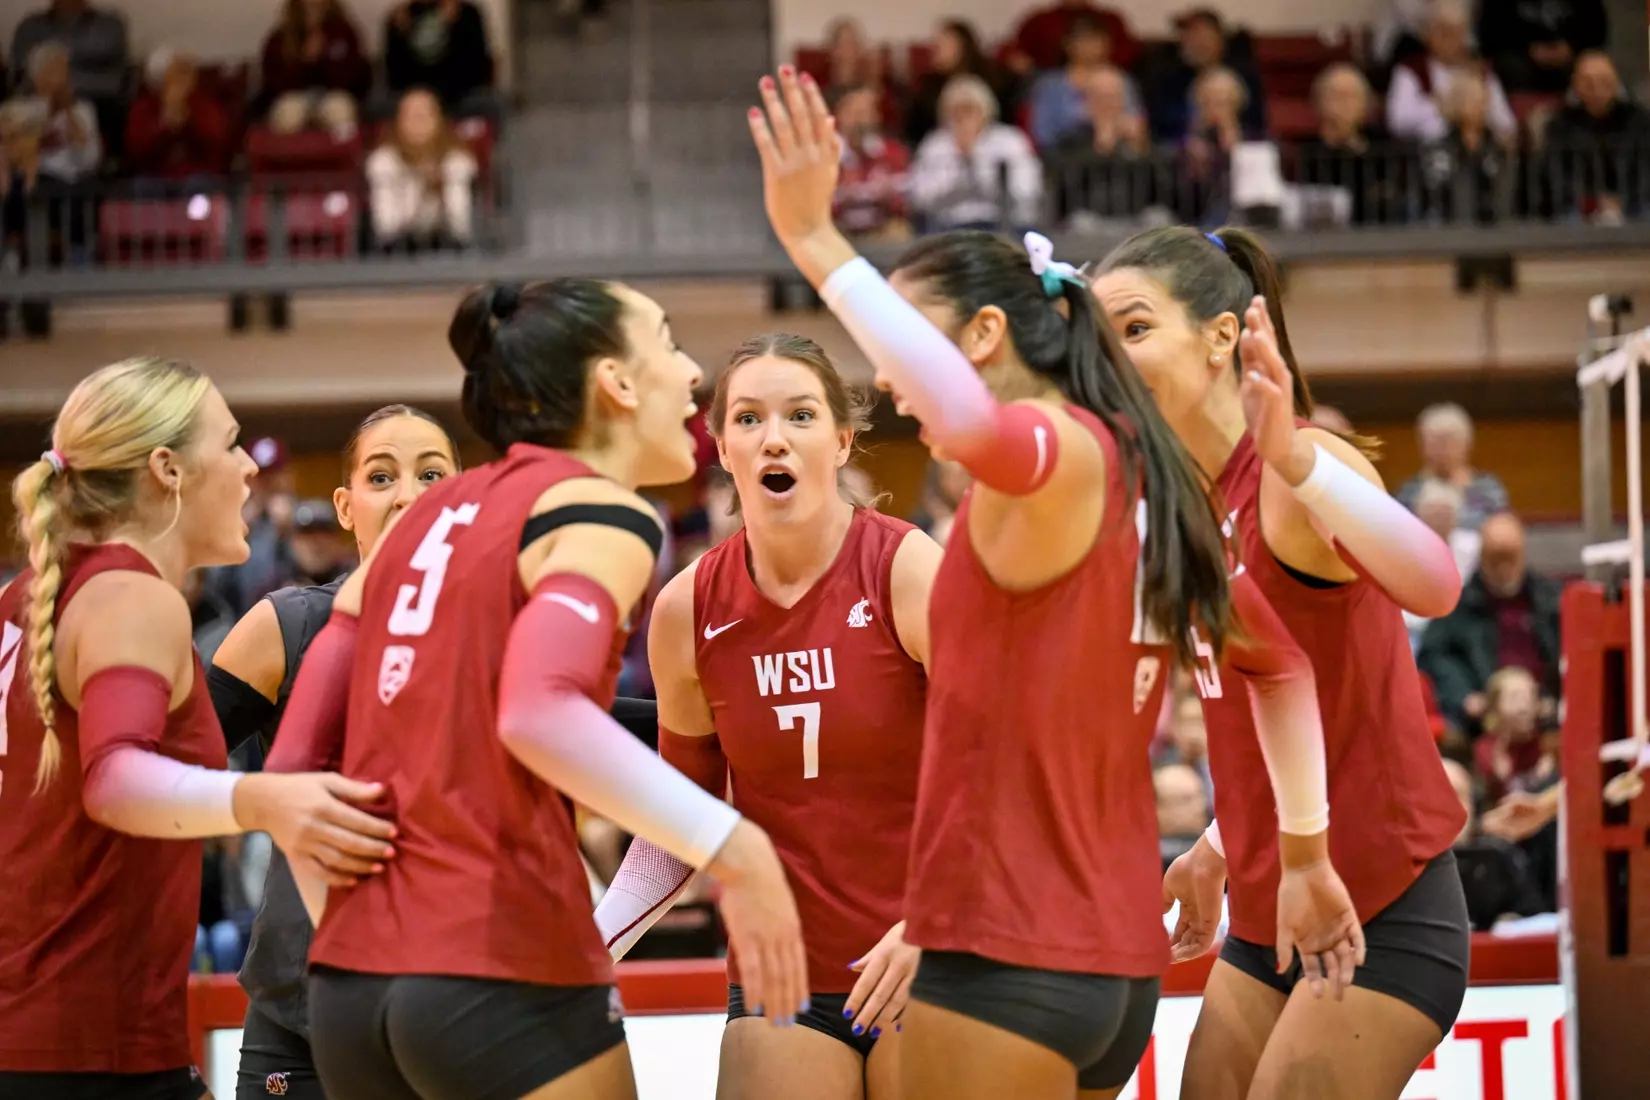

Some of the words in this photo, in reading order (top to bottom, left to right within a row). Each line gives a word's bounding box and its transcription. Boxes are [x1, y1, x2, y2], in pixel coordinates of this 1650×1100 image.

[388, 502, 481, 636] 5
[751, 647, 836, 697] WSU
[771, 701, 821, 780] 7
